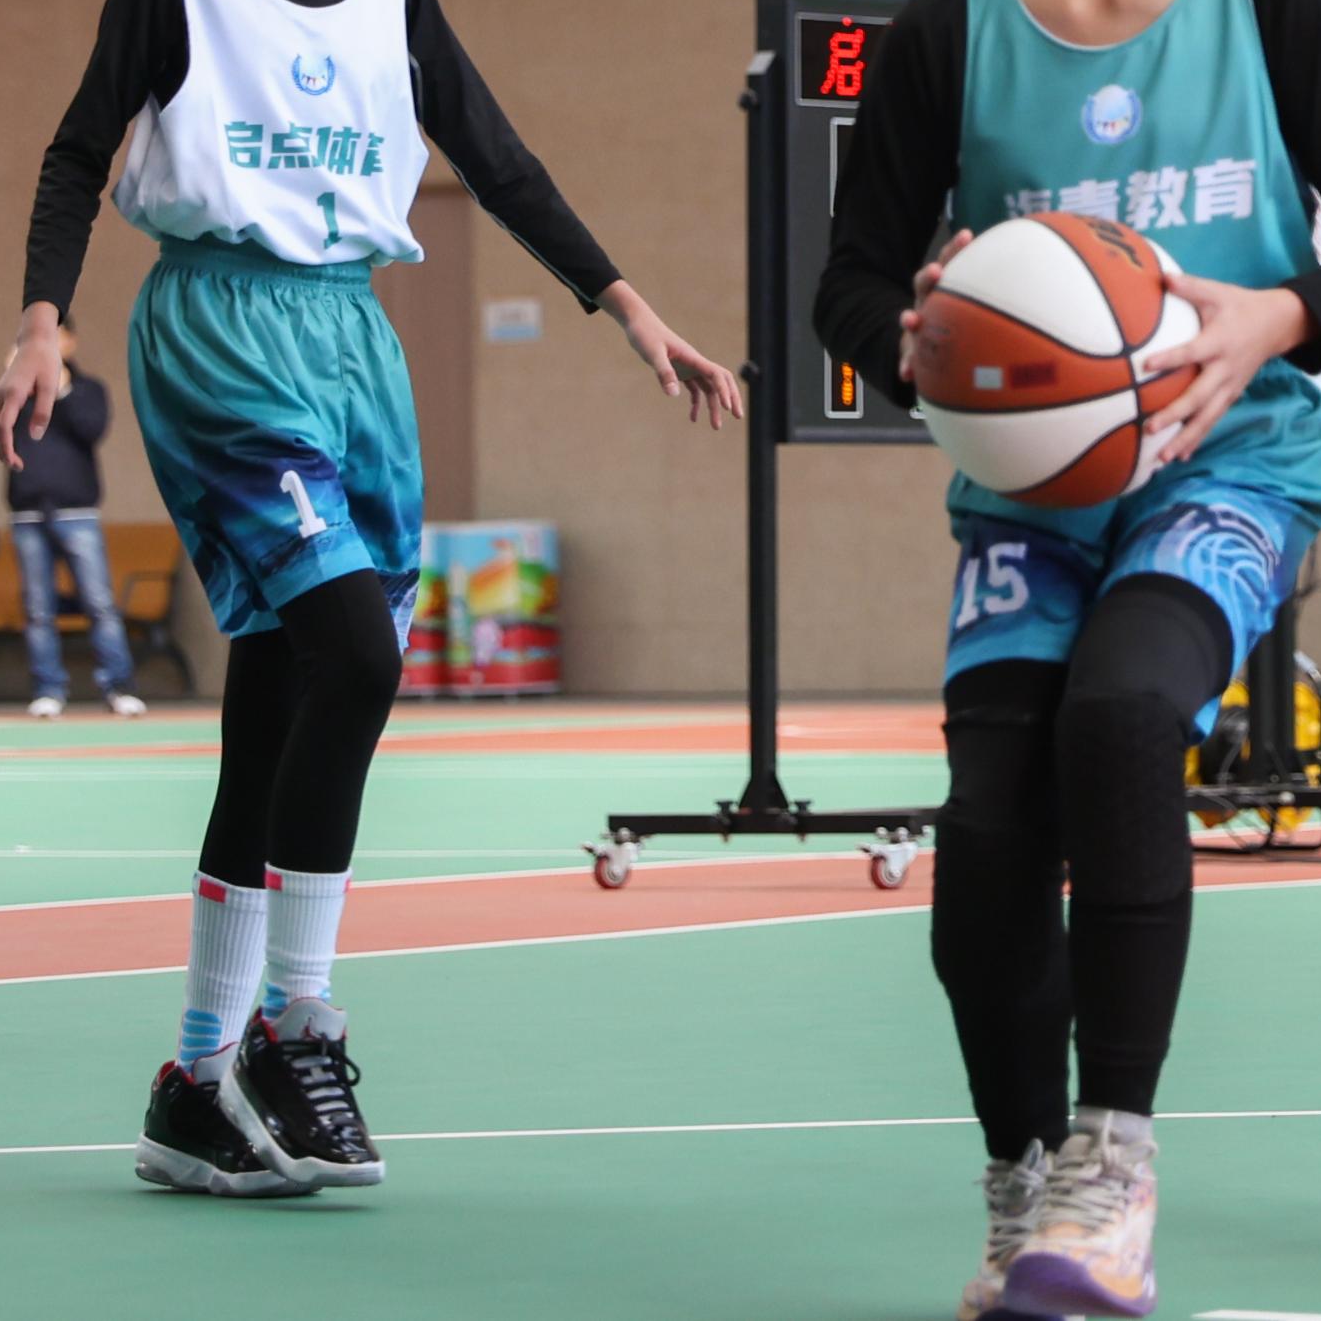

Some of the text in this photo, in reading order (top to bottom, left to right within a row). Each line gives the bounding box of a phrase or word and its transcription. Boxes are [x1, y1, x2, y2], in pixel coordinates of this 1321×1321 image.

[820, 16, 866, 96] 启
[316, 191, 342, 250] 1
[279, 470, 327, 540] 1
[955, 542, 1031, 628] 15
